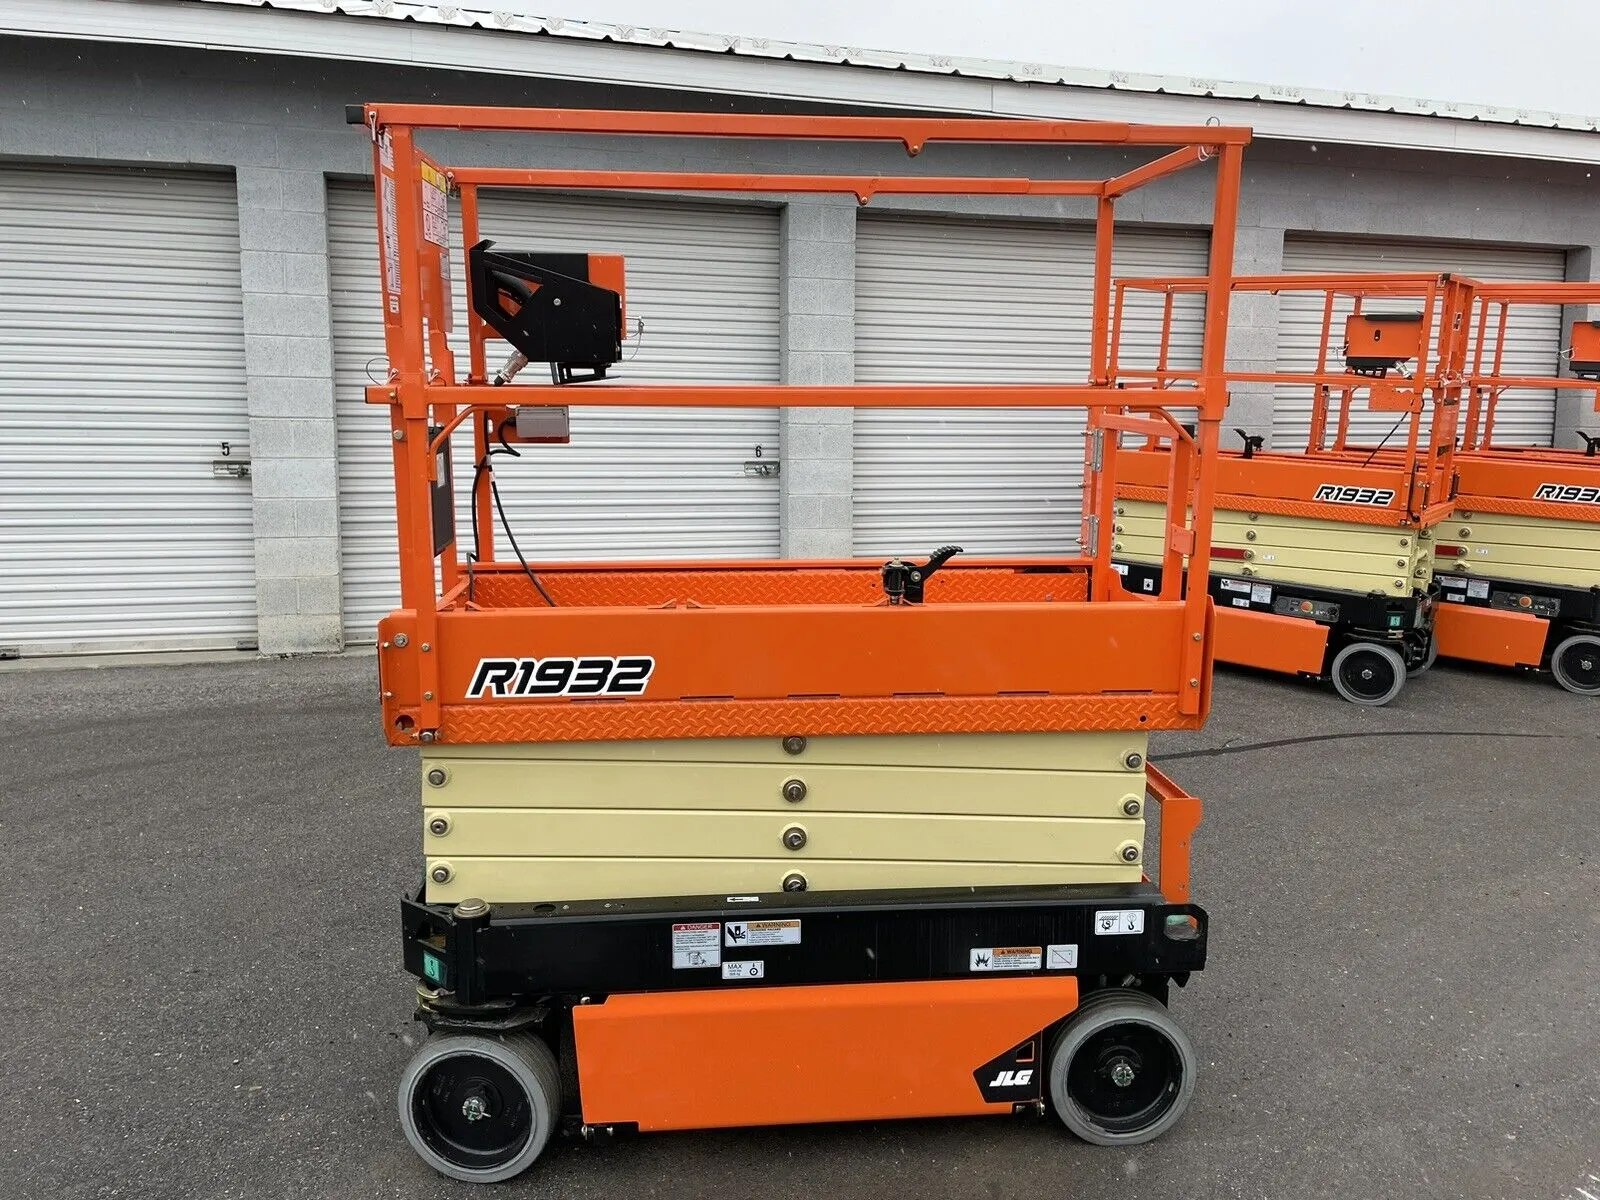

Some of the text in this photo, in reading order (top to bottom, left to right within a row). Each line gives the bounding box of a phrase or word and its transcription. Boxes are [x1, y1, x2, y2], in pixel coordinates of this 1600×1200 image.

[222, 442, 230, 456] 5
[755, 445, 762, 458] 6
[1313, 484, 1395, 507] R1932
[465, 656, 655, 699] R1932
[989, 1069, 1034, 1087] JLG
